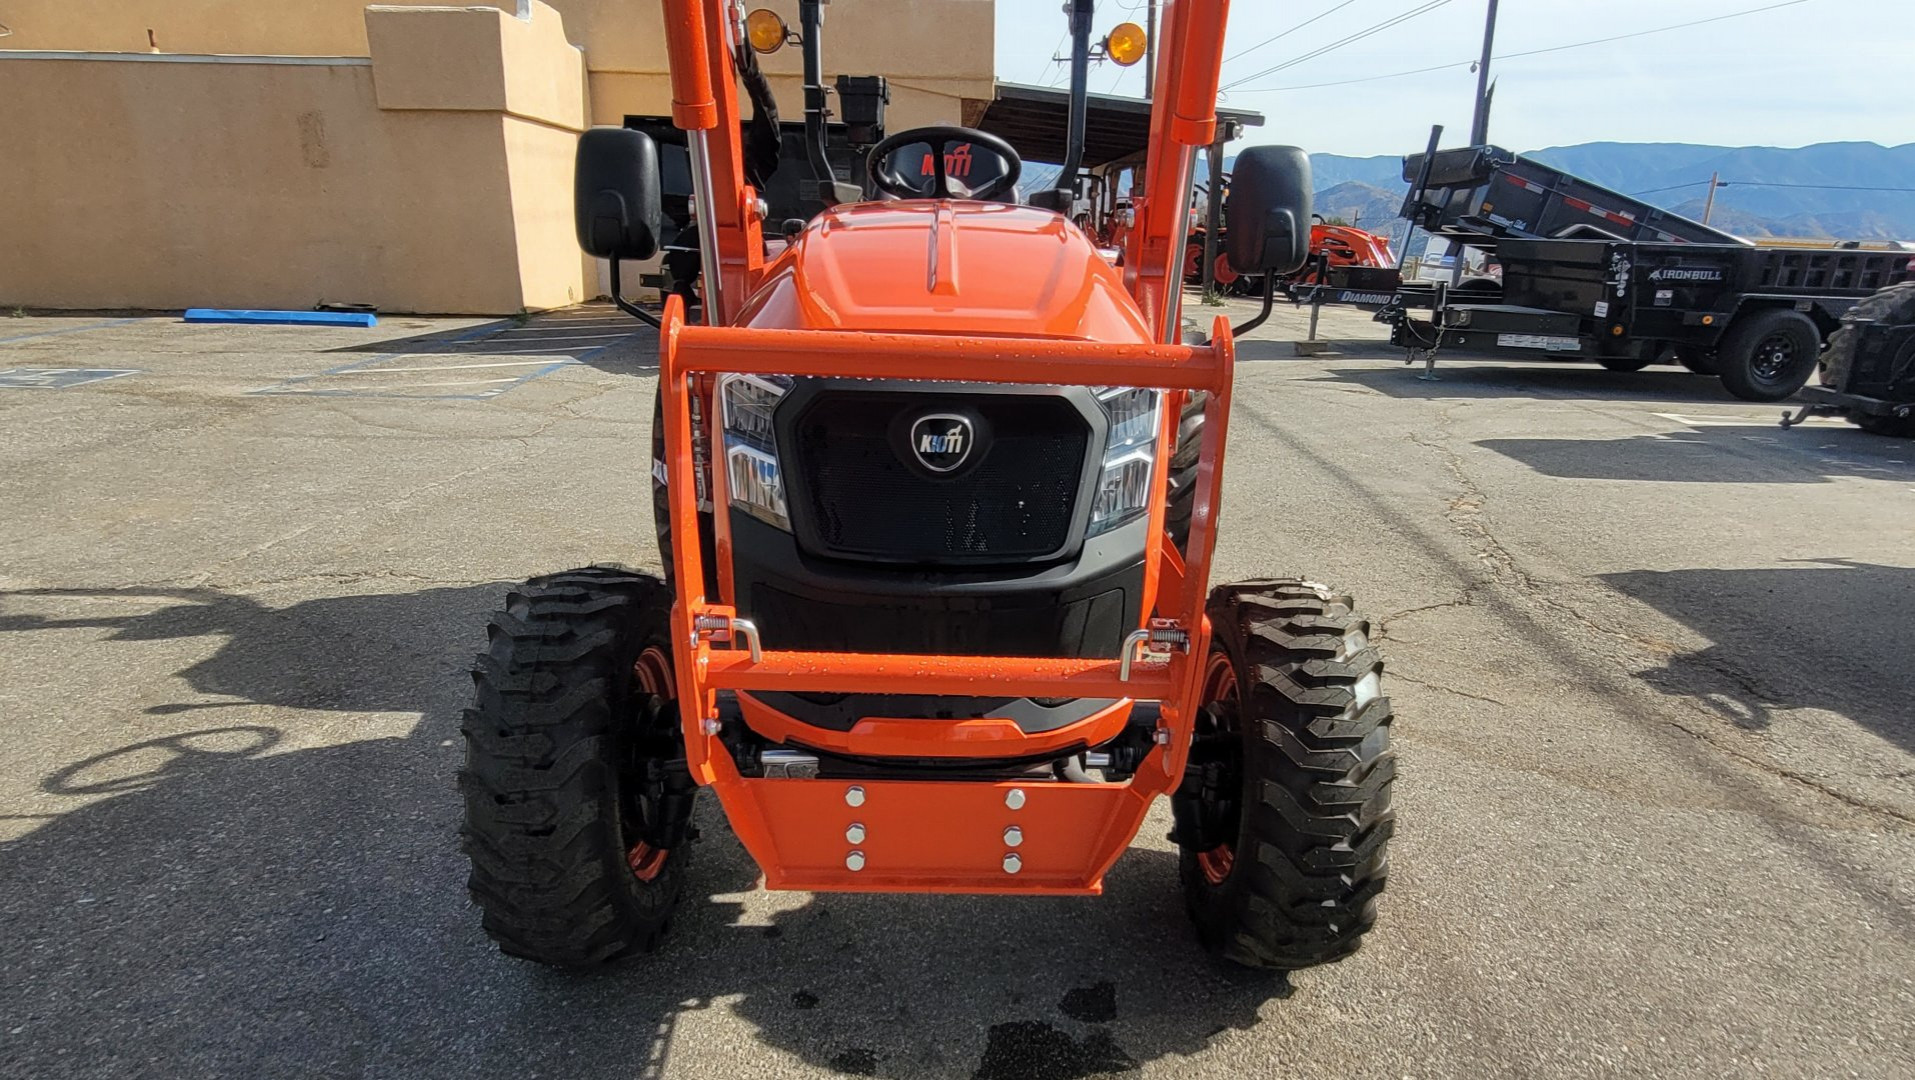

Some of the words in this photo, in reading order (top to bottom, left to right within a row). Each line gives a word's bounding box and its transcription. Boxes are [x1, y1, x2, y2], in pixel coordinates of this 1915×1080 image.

[921, 152, 972, 176] KOTI
[1662, 269, 1722, 281] IRONBULL
[1391, 294, 1402, 305] C
[920, 433, 963, 453] KIOTI
